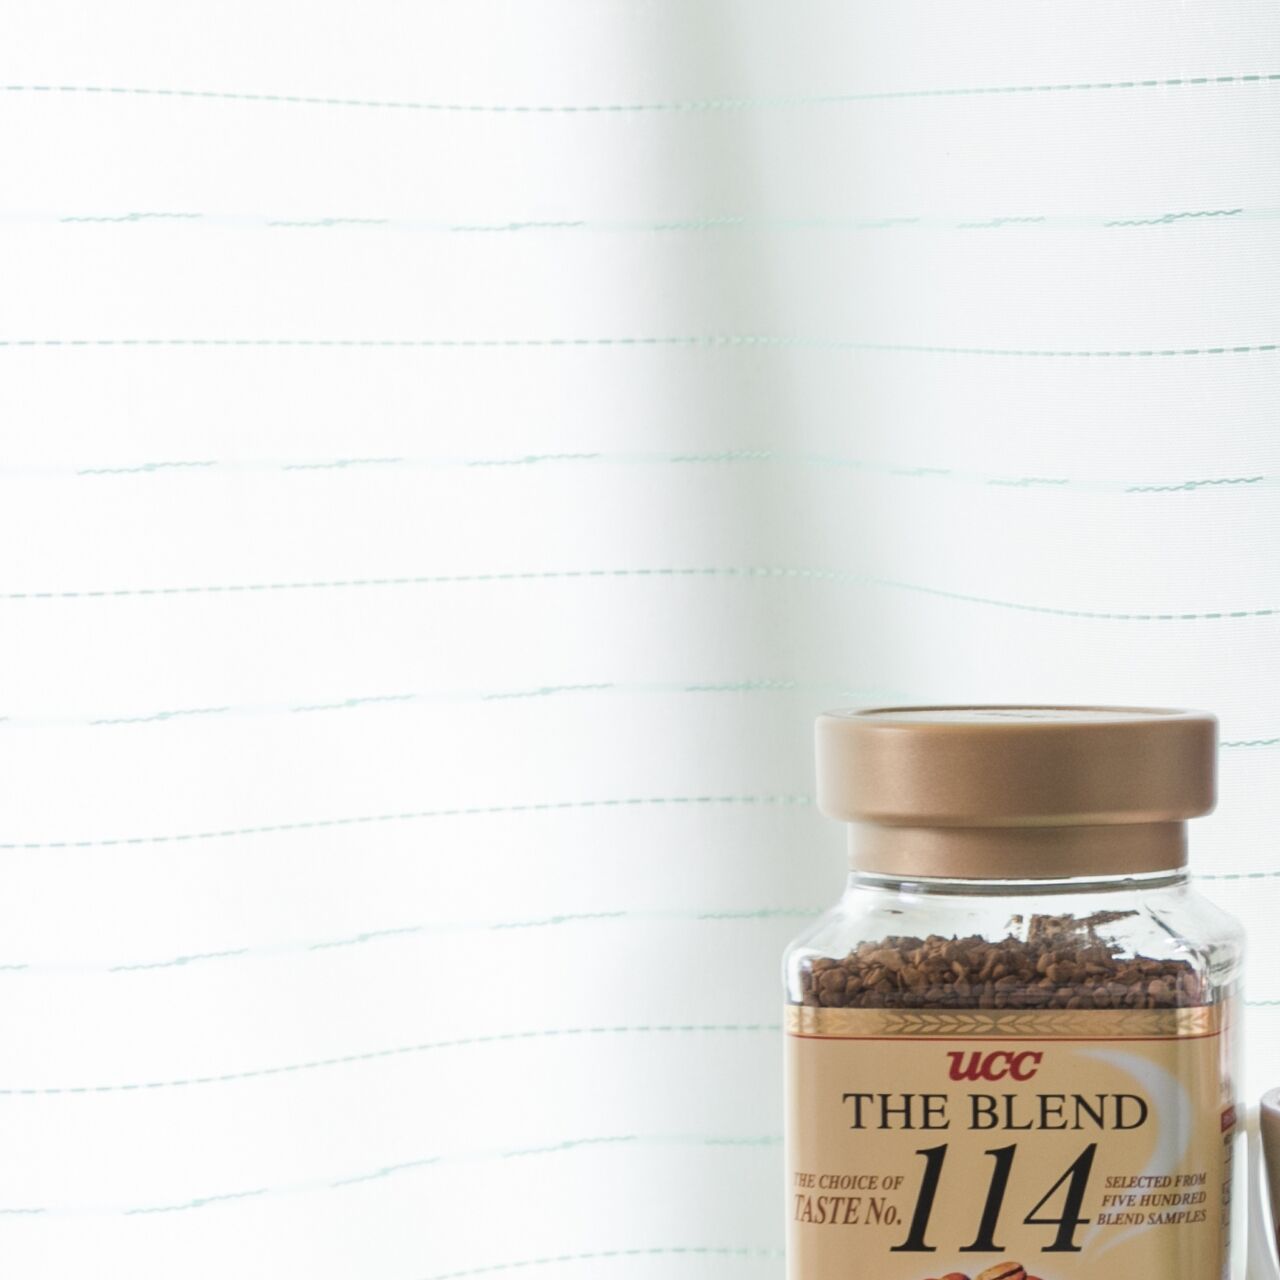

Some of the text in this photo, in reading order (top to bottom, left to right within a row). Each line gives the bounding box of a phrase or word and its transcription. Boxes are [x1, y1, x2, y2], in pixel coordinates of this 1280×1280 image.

[842, 1093, 1149, 1131] THE BLEND
[794, 1172, 904, 1190] THE CHOICE OF
[1104, 1172, 1207, 1189] SELECTED FROM
[889, 1142, 1098, 1253] 114
[1101, 1191, 1207, 1207] FIVE HUNDRED
[794, 1194, 902, 1226] TASTE No.
[1096, 1209, 1207, 1226] BLEND SAMPLES
